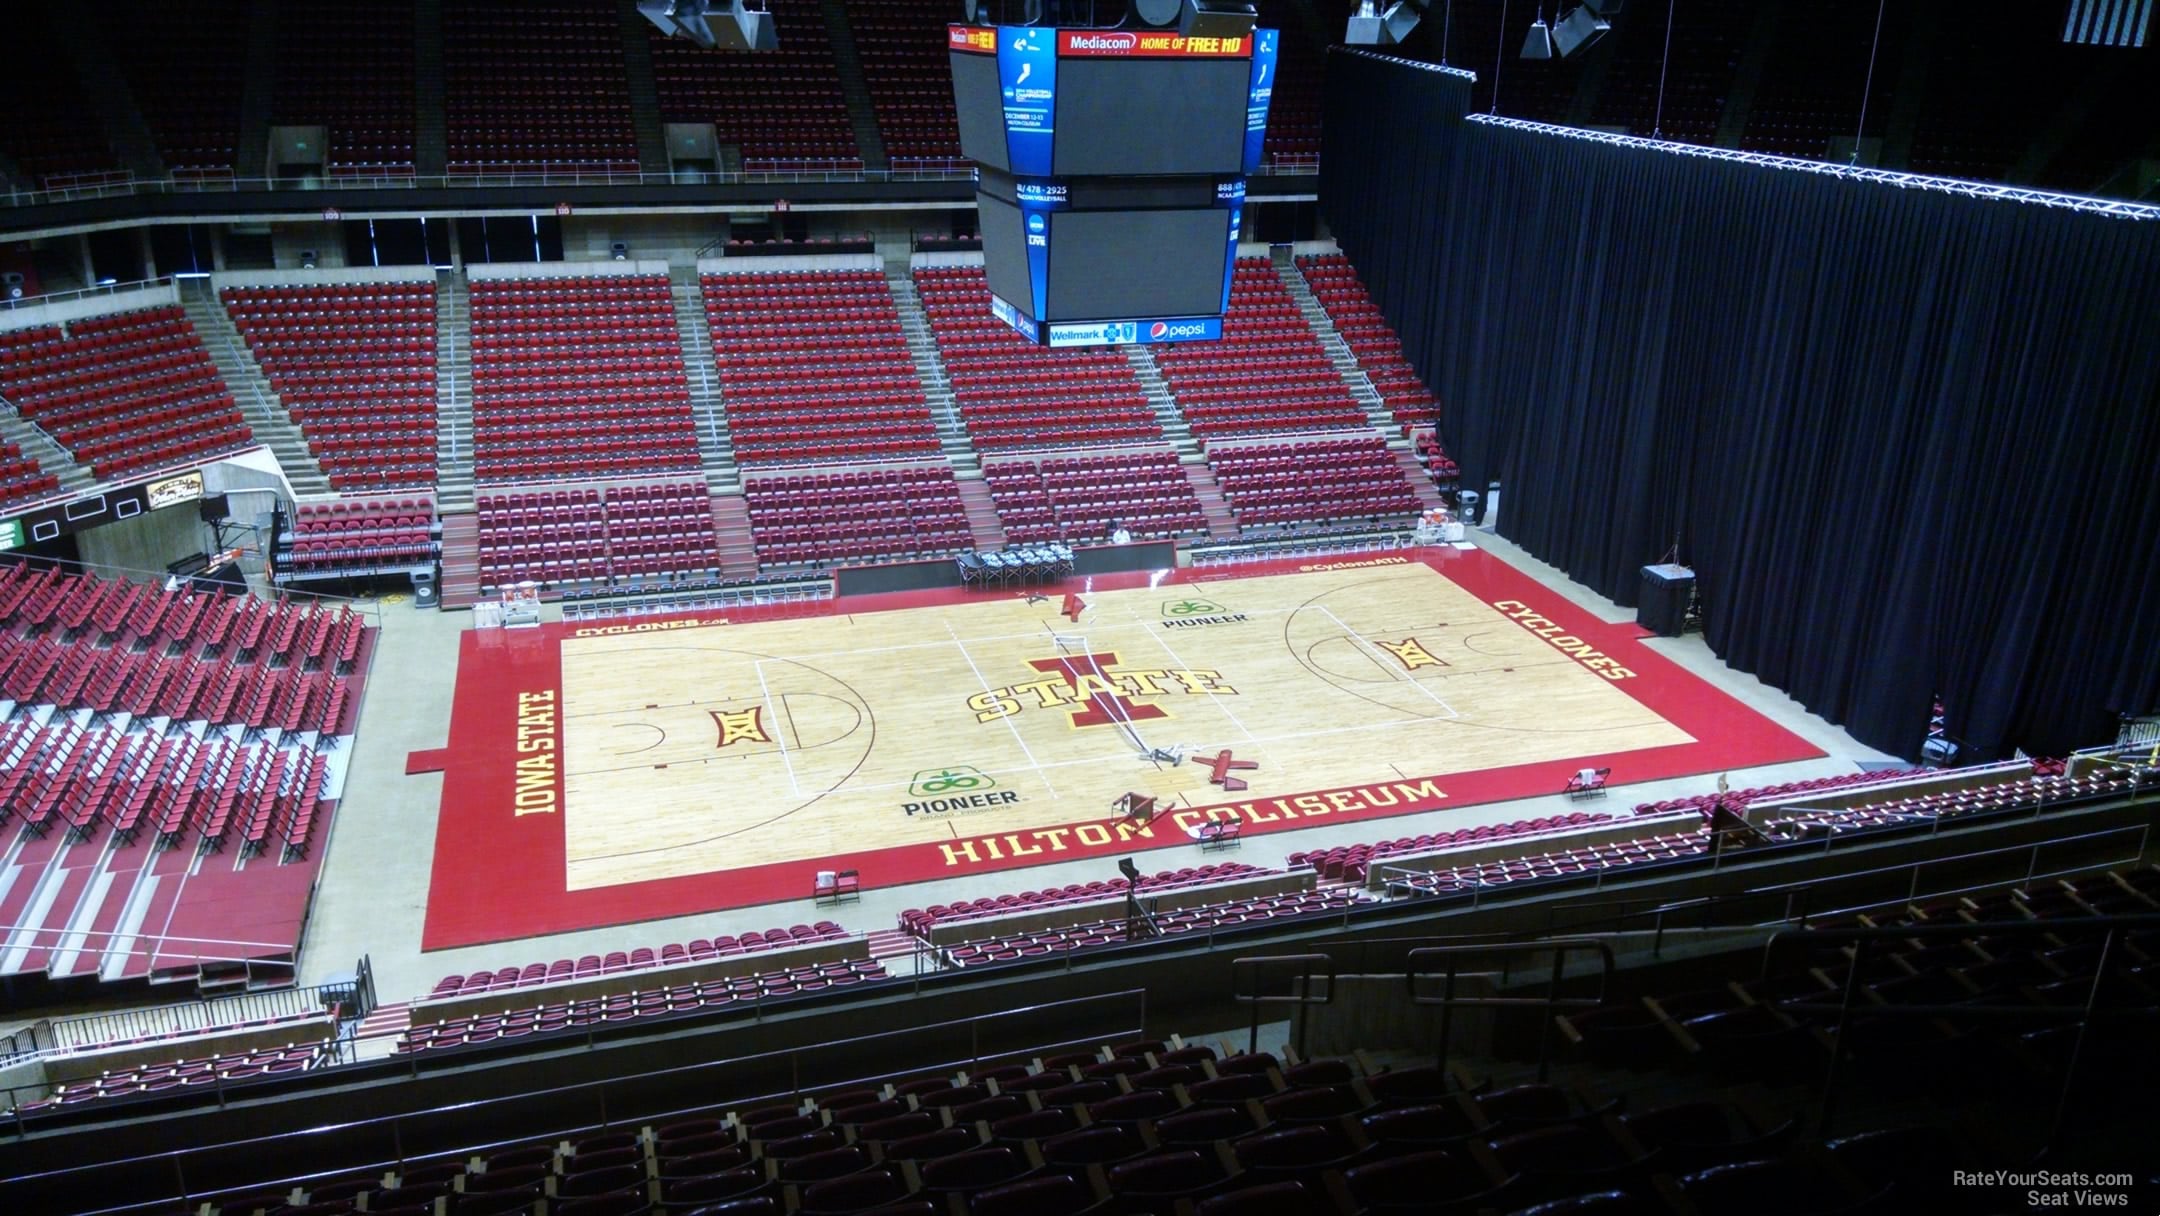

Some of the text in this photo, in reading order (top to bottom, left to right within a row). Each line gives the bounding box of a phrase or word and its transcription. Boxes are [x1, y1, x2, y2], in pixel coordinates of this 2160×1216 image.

[1070, 35, 1242, 53] Mediacom HOME OF FREE HD
[1026, 185, 1041, 193] 478
[1046, 186, 1067, 194] 2925
[1052, 331, 1099, 341] Wellmark
[1169, 325, 1206, 338] pepsi
[1162, 614, 1249, 628] PIONEER
[1493, 600, 1638, 680] CYCLONES
[966, 669, 1240, 724] STATE
[515, 690, 556, 817] IOWA STATE
[901, 791, 1020, 816] PIONEER
[938, 780, 1448, 866] HILTON COLISEUM
